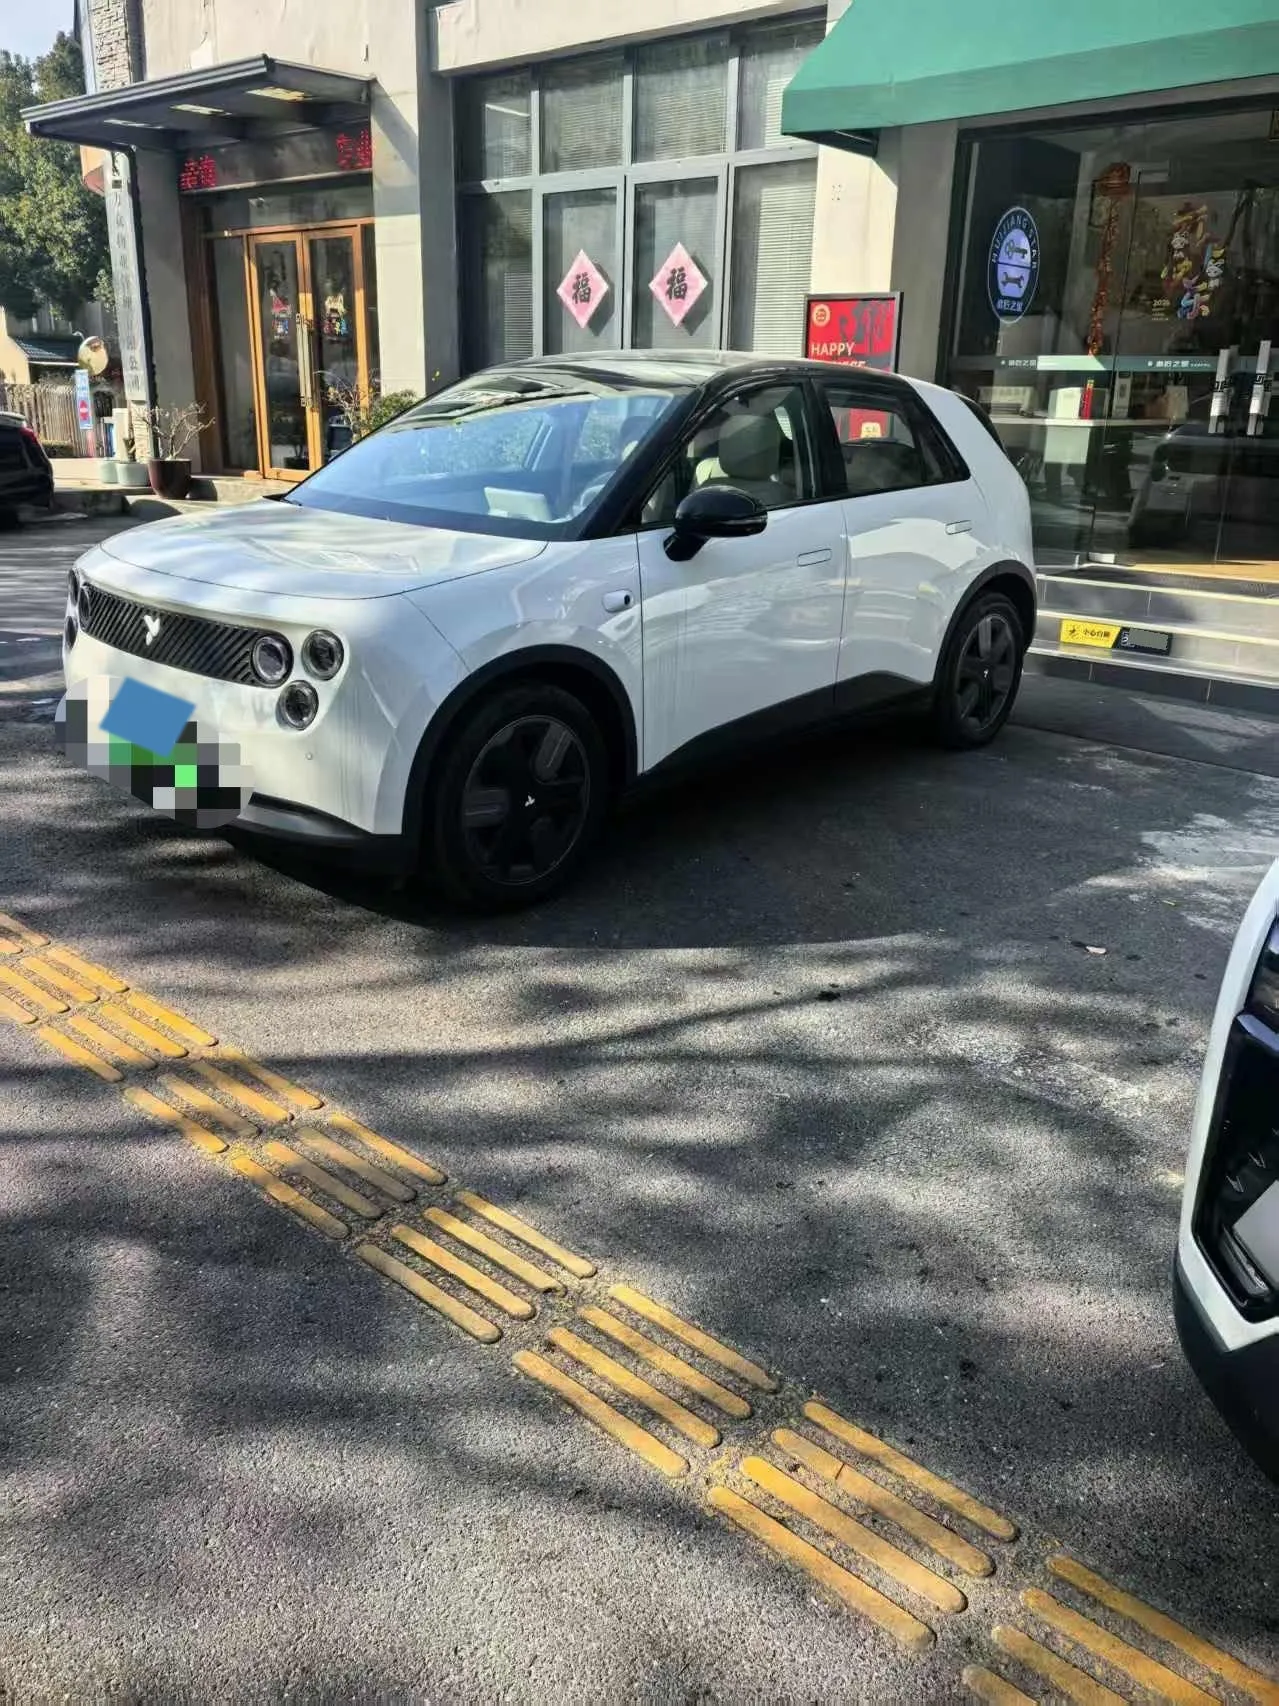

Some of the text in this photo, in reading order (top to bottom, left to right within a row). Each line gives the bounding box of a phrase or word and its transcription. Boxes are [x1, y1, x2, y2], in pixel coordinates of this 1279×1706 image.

[572, 271, 592, 304] 福
[665, 266, 688, 300] 福
[810, 342, 855, 356] HAPPY
